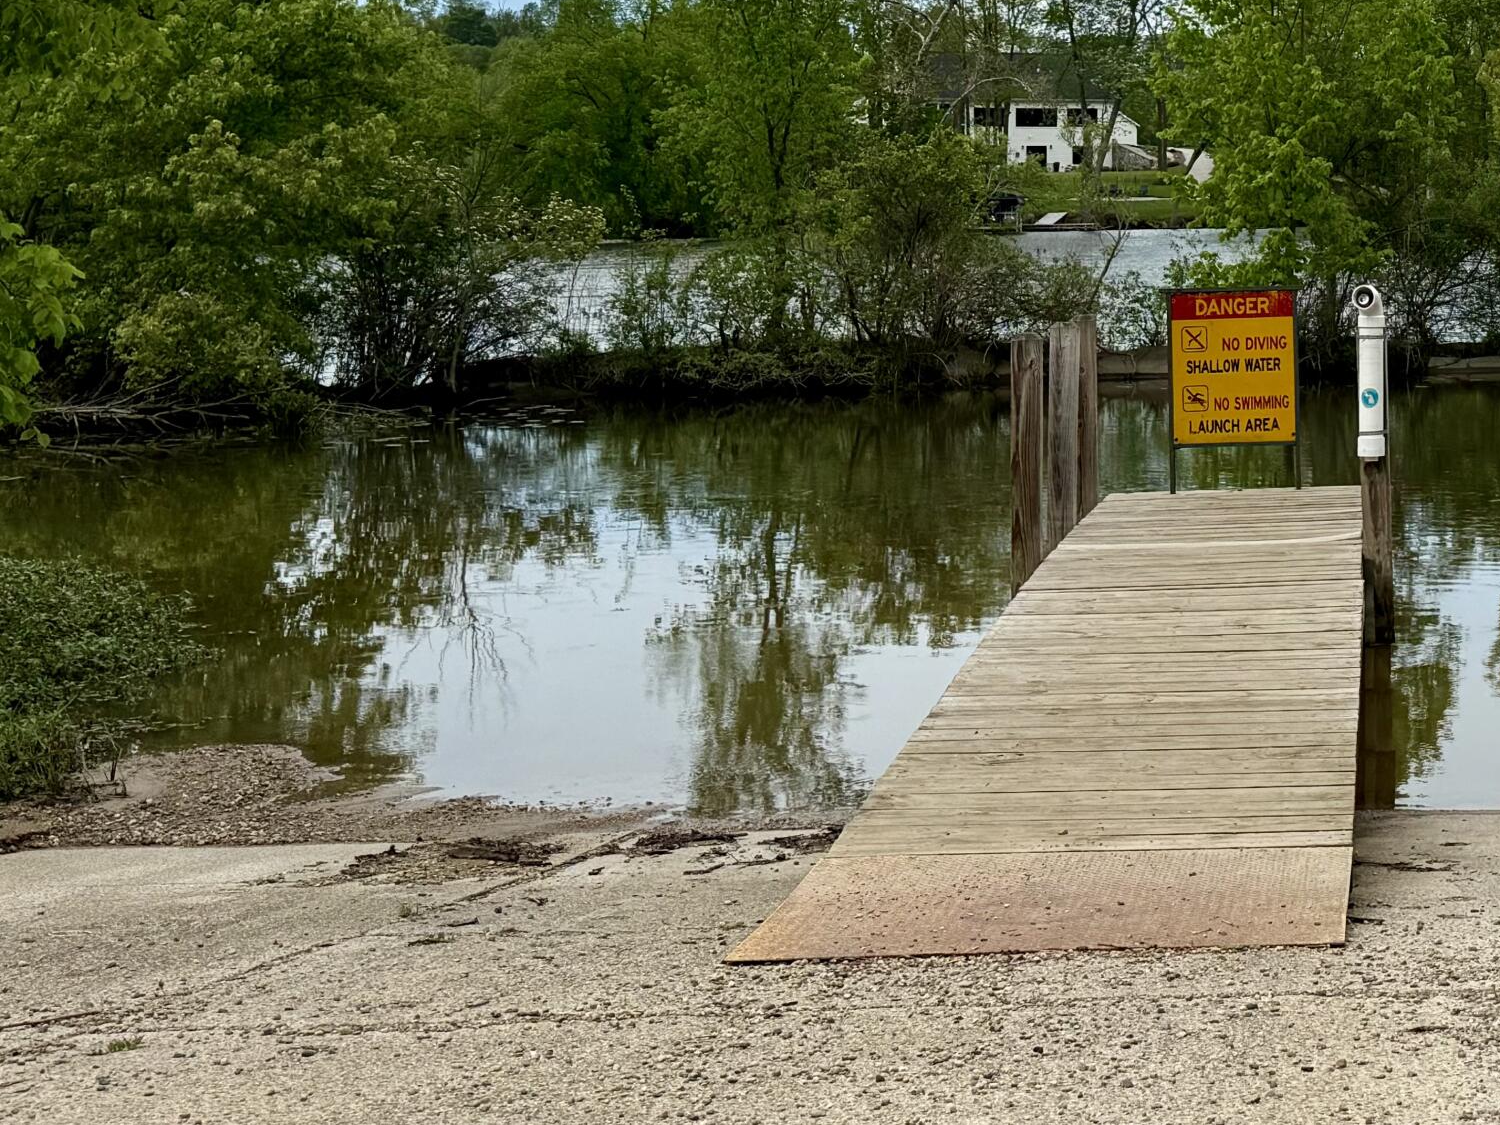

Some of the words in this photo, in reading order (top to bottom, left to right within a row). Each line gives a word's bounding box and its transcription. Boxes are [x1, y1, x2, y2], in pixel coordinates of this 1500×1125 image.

[1195, 297, 1270, 316] DANGER
[1222, 337, 1240, 351] NO
[1245, 335, 1288, 350] DIVING
[1186, 358, 1240, 374] SHALLOW
[1244, 357, 1281, 372] WATER
[1214, 397, 1230, 411] NO
[1234, 395, 1290, 410] SWIMMING
[1189, 419, 1240, 435] LAUNCH
[1244, 418, 1280, 432] AREA
